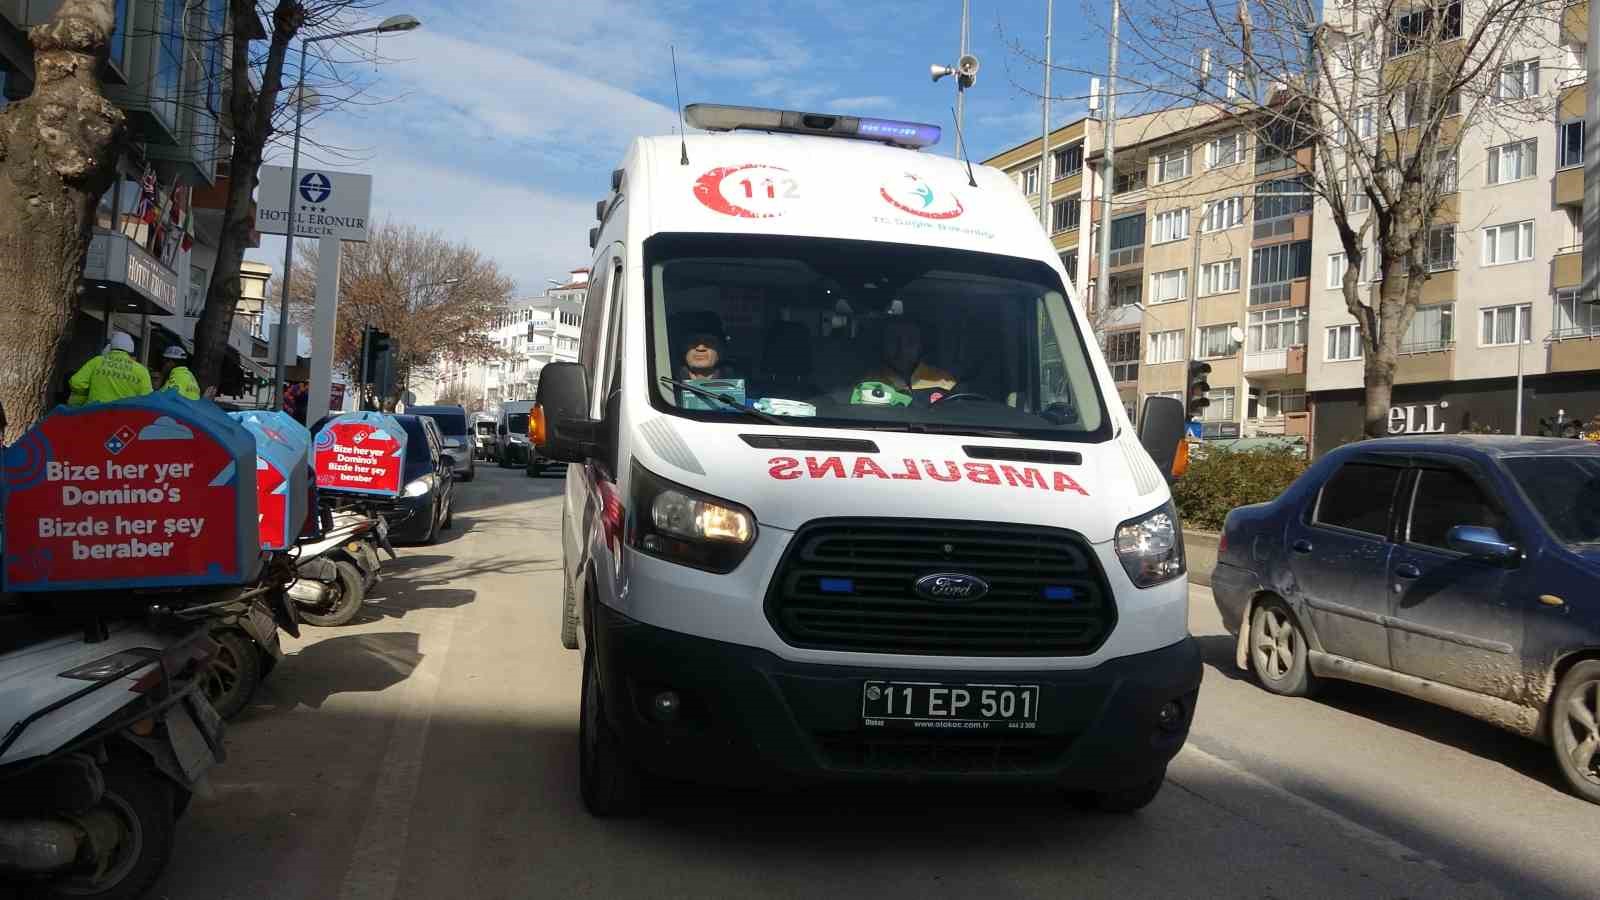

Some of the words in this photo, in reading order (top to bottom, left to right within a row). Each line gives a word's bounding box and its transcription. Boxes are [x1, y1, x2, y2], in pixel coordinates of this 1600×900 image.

[738, 177, 801, 199] 112
[294, 224, 333, 235] İLECİK
[308, 214, 365, 230] ERONUR
[128, 254, 151, 288] HOTEL
[151, 273, 177, 305] ERONUR
[333, 444, 352, 454] Bize
[353, 446, 368, 455] her
[368, 449, 384, 457] yer
[337, 453, 377, 464] Domino's
[46, 461, 100, 481] Bize
[106, 460, 149, 480] her
[154, 462, 194, 483] yer
[328, 462, 353, 472] Bizde
[354, 465, 370, 473] her
[340, 473, 373, 483] beraber
[62, 483, 181, 506] Domino's
[38, 516, 108, 537] Bizde
[115, 515, 157, 535] her
[163, 517, 205, 537] şey
[72, 538, 174, 560] beraber
[931, 577, 973, 596] Ford
[883, 687, 913, 715] 11
[928, 688, 971, 717] EP
[980, 690, 1031, 718] 501
